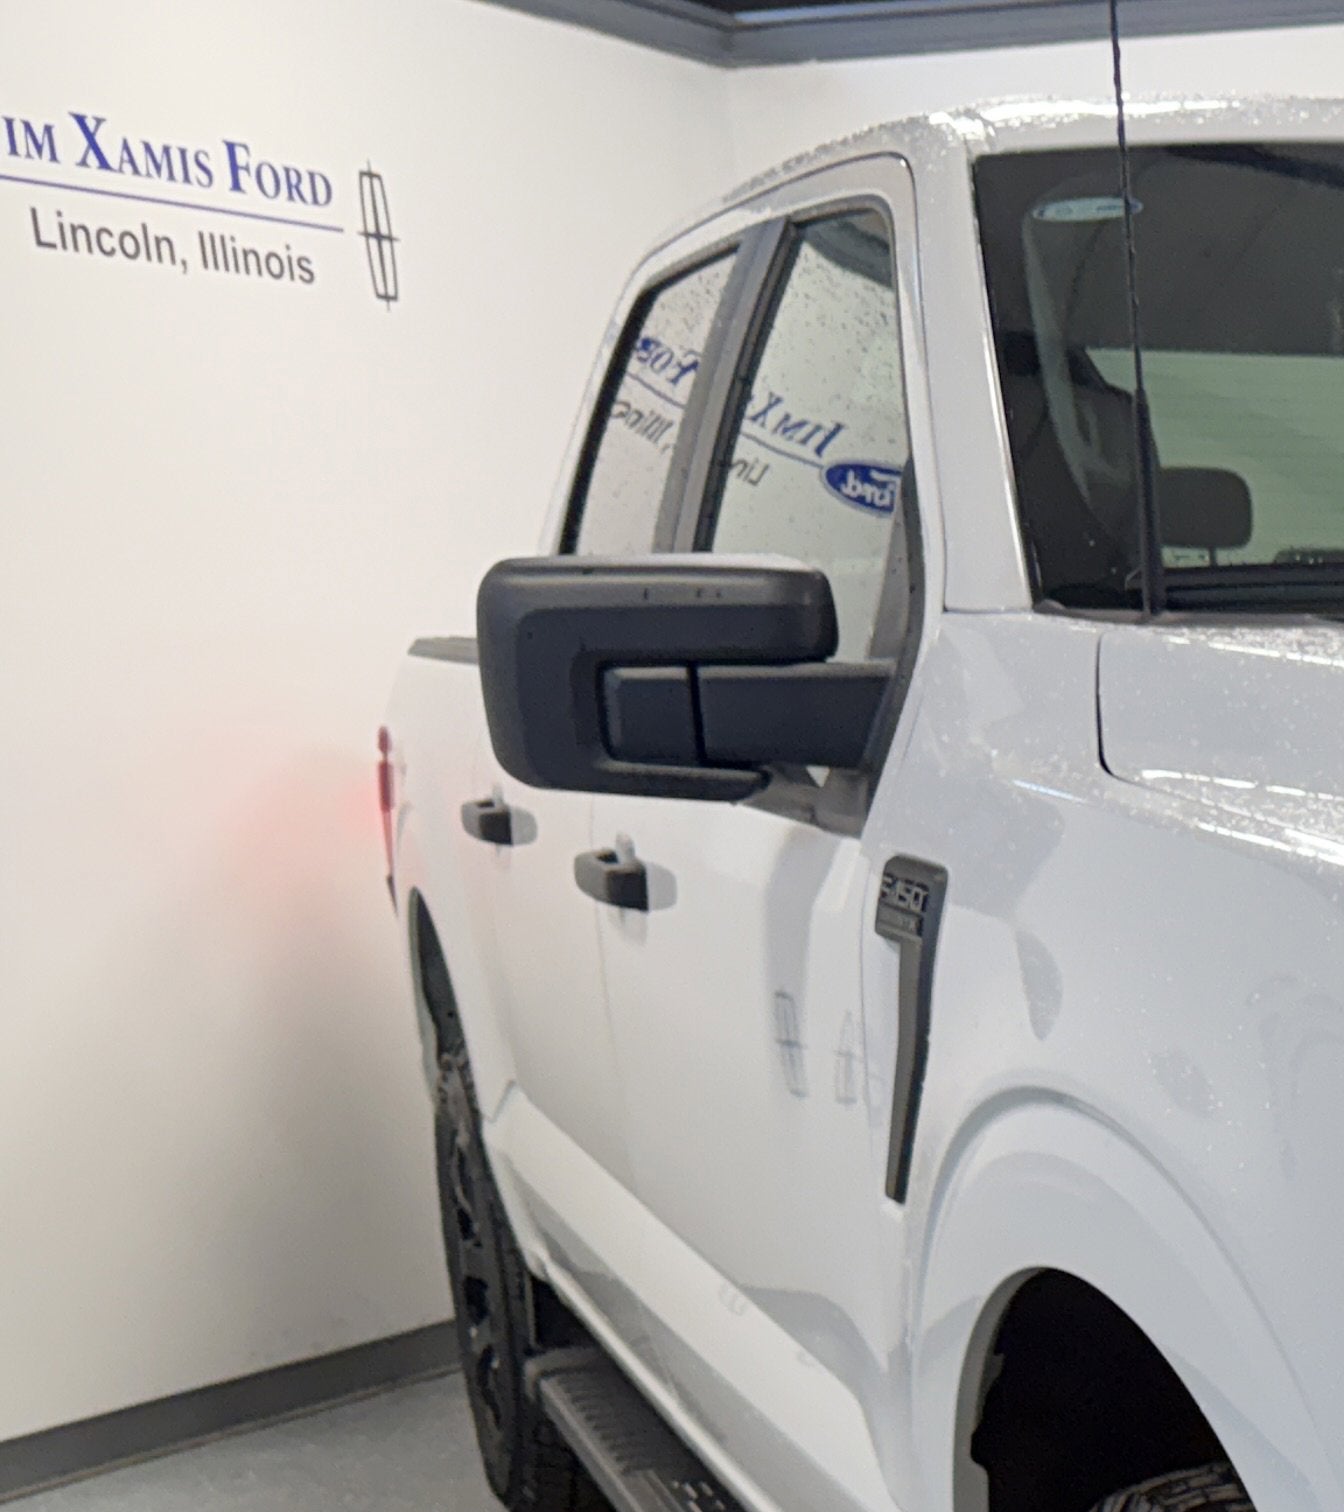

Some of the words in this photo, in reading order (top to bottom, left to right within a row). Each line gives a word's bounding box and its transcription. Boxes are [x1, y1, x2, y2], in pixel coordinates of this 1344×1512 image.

[2, 115, 61, 164] IM
[68, 112, 214, 188] XAMIS
[222, 140, 333, 207] FORD
[30, 206, 188, 274] Lincoln,
[198, 231, 316, 285] Illinois
